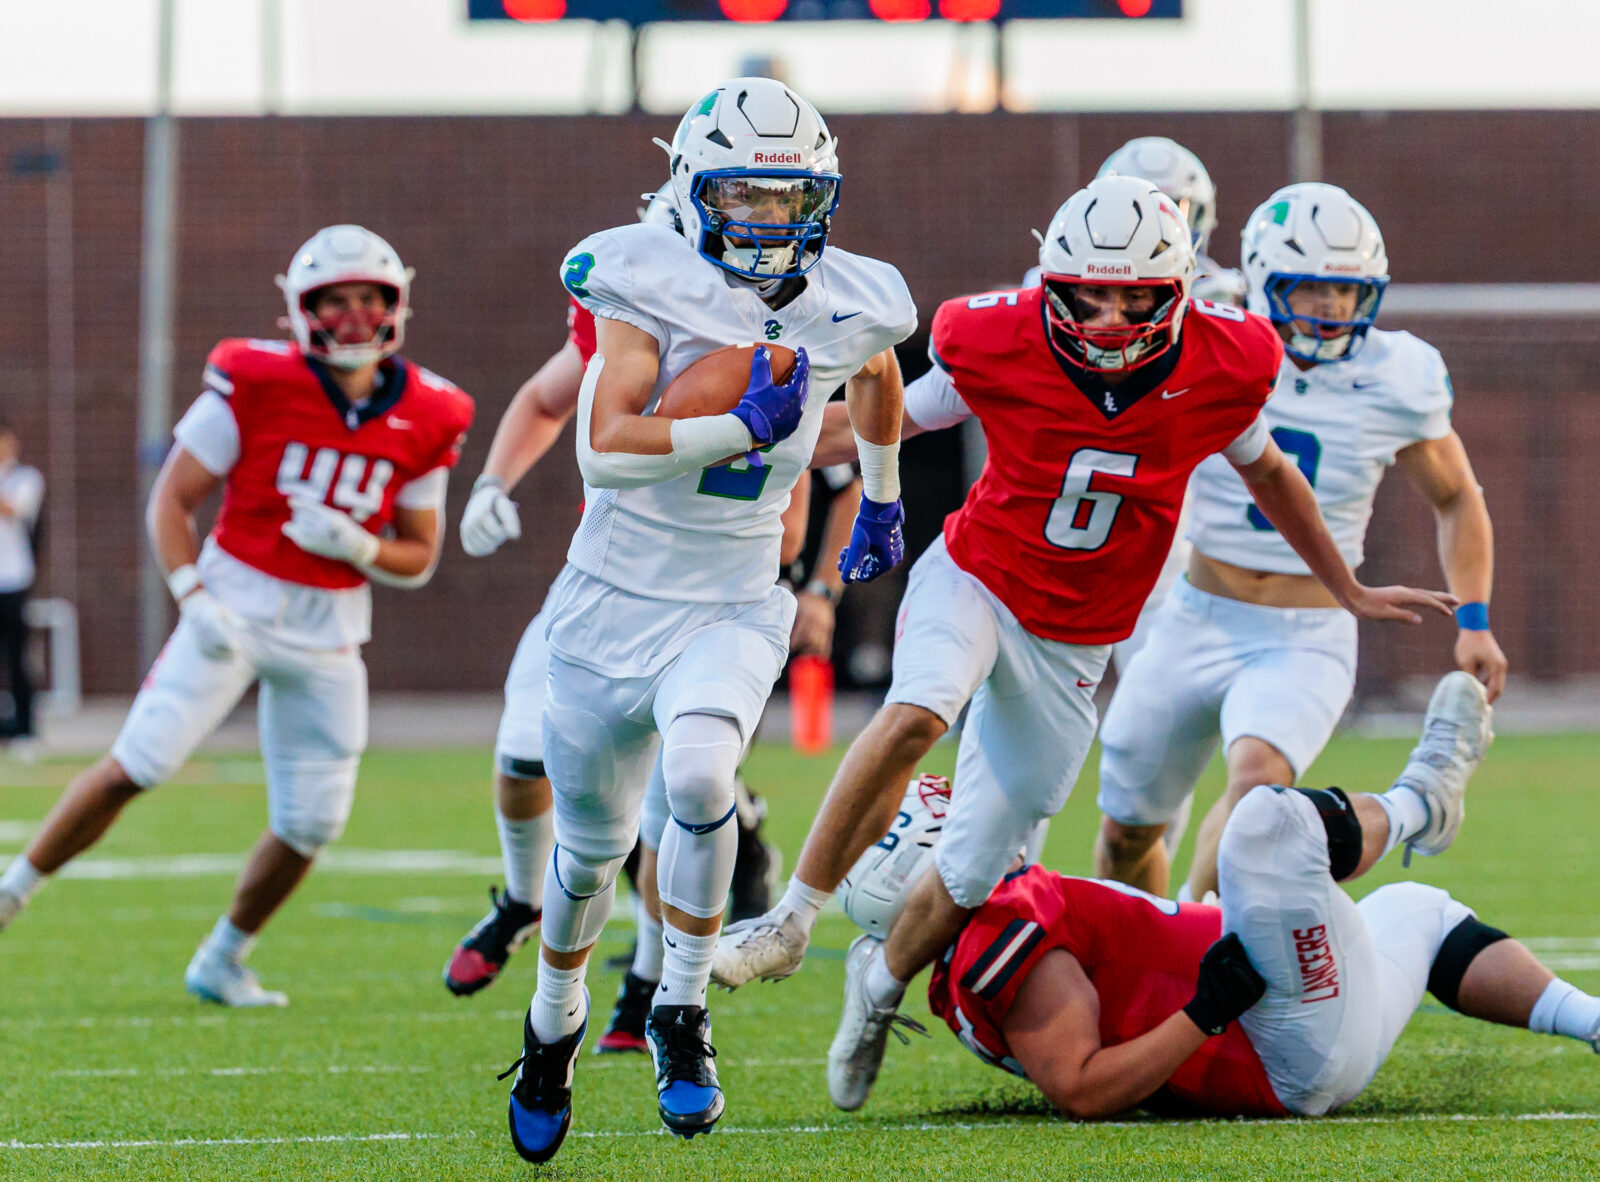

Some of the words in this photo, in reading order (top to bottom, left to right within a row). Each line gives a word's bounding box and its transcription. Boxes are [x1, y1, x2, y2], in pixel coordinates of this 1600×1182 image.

[754, 152, 801, 164] Riddell
[564, 252, 595, 299] 2
[1087, 264, 1131, 275] Riddell
[276, 441, 395, 523] 44
[1044, 446, 1141, 552] 6
[1292, 924, 1339, 1004] LANCERS
